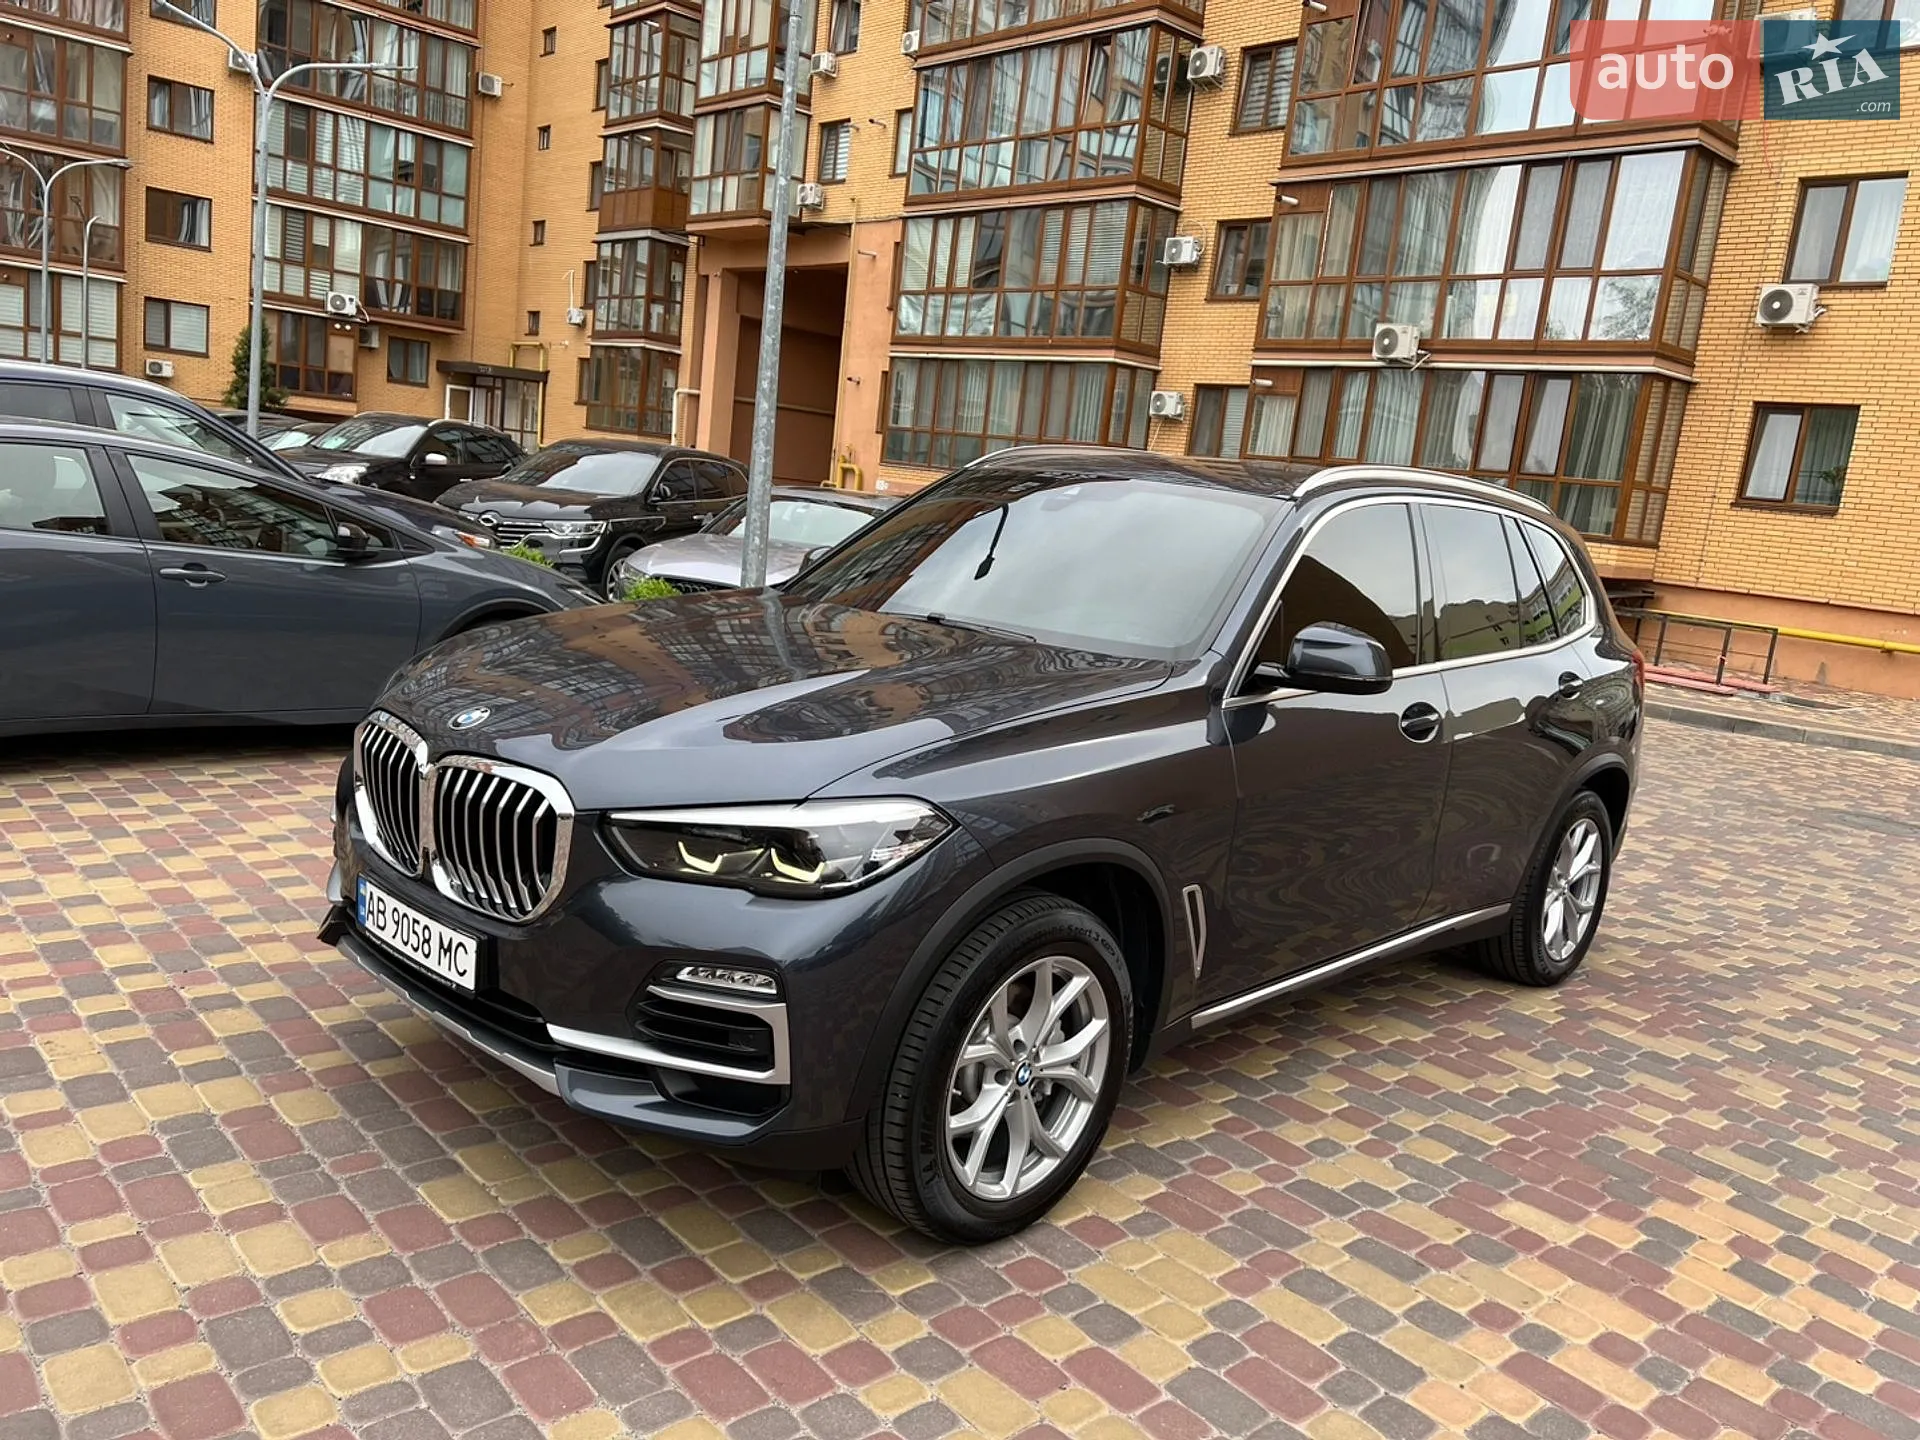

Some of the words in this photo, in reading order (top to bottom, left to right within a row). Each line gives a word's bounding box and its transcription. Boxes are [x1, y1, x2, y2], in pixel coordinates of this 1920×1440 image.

[366, 891, 387, 931] AB
[391, 907, 432, 959] 9058
[437, 931, 468, 978] MC
